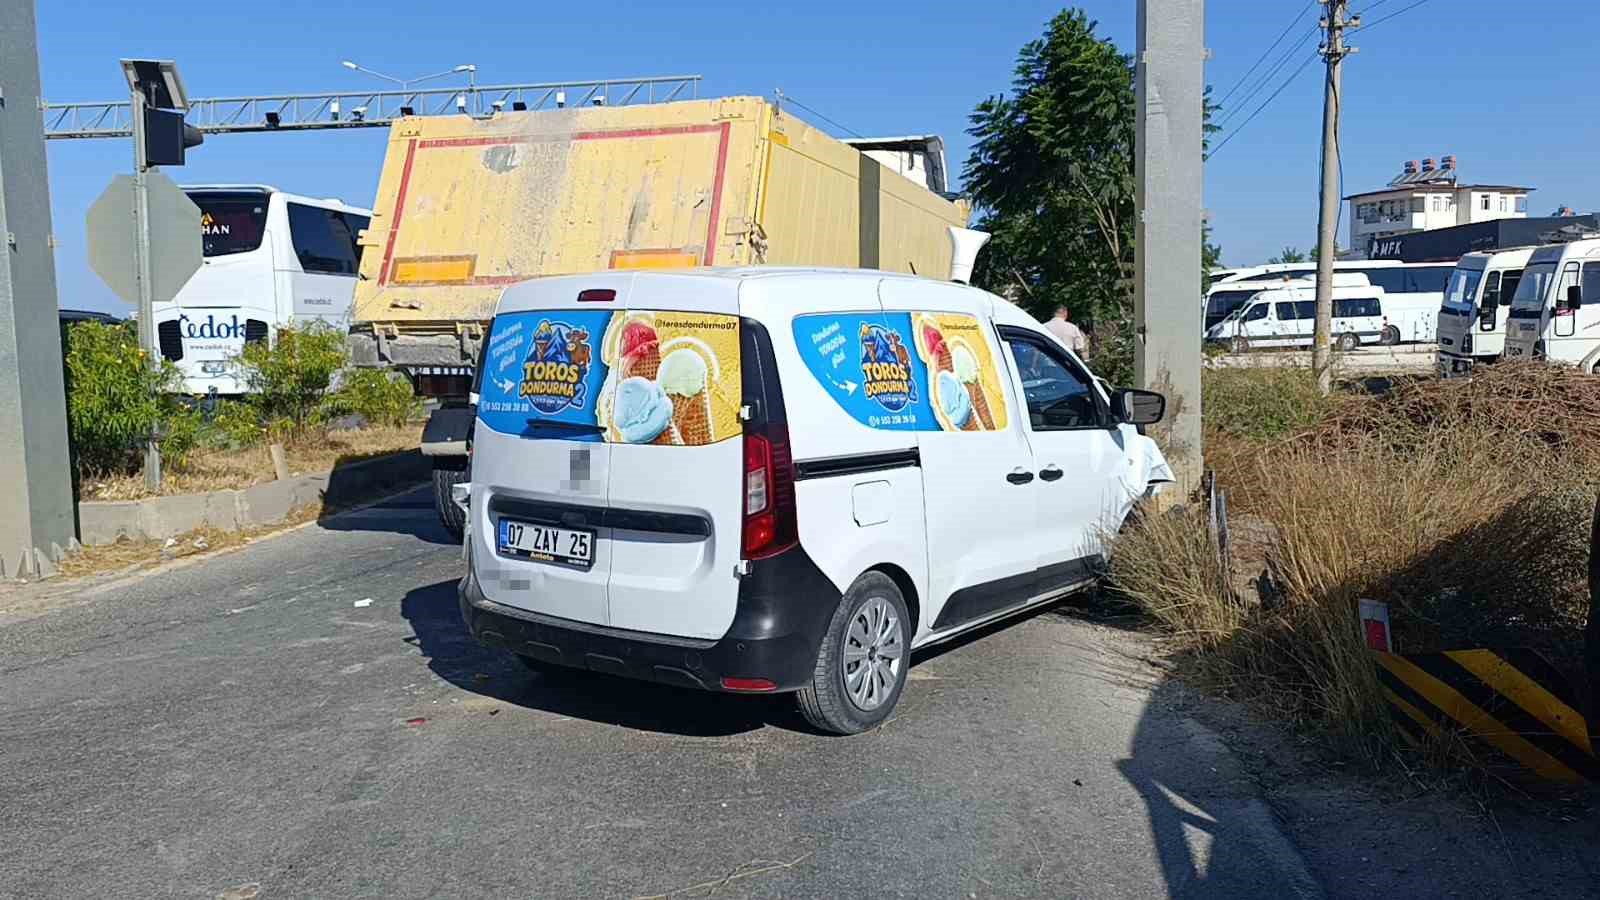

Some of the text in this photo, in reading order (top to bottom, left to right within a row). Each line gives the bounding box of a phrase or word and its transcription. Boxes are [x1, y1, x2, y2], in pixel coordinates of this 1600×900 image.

[524, 361, 580, 383] TOROS
[863, 362, 909, 381] TOROS
[519, 381, 575, 397] DONDURMA
[864, 381, 910, 396] DONDURMA
[508, 525, 587, 557] 07 ZAY 25
